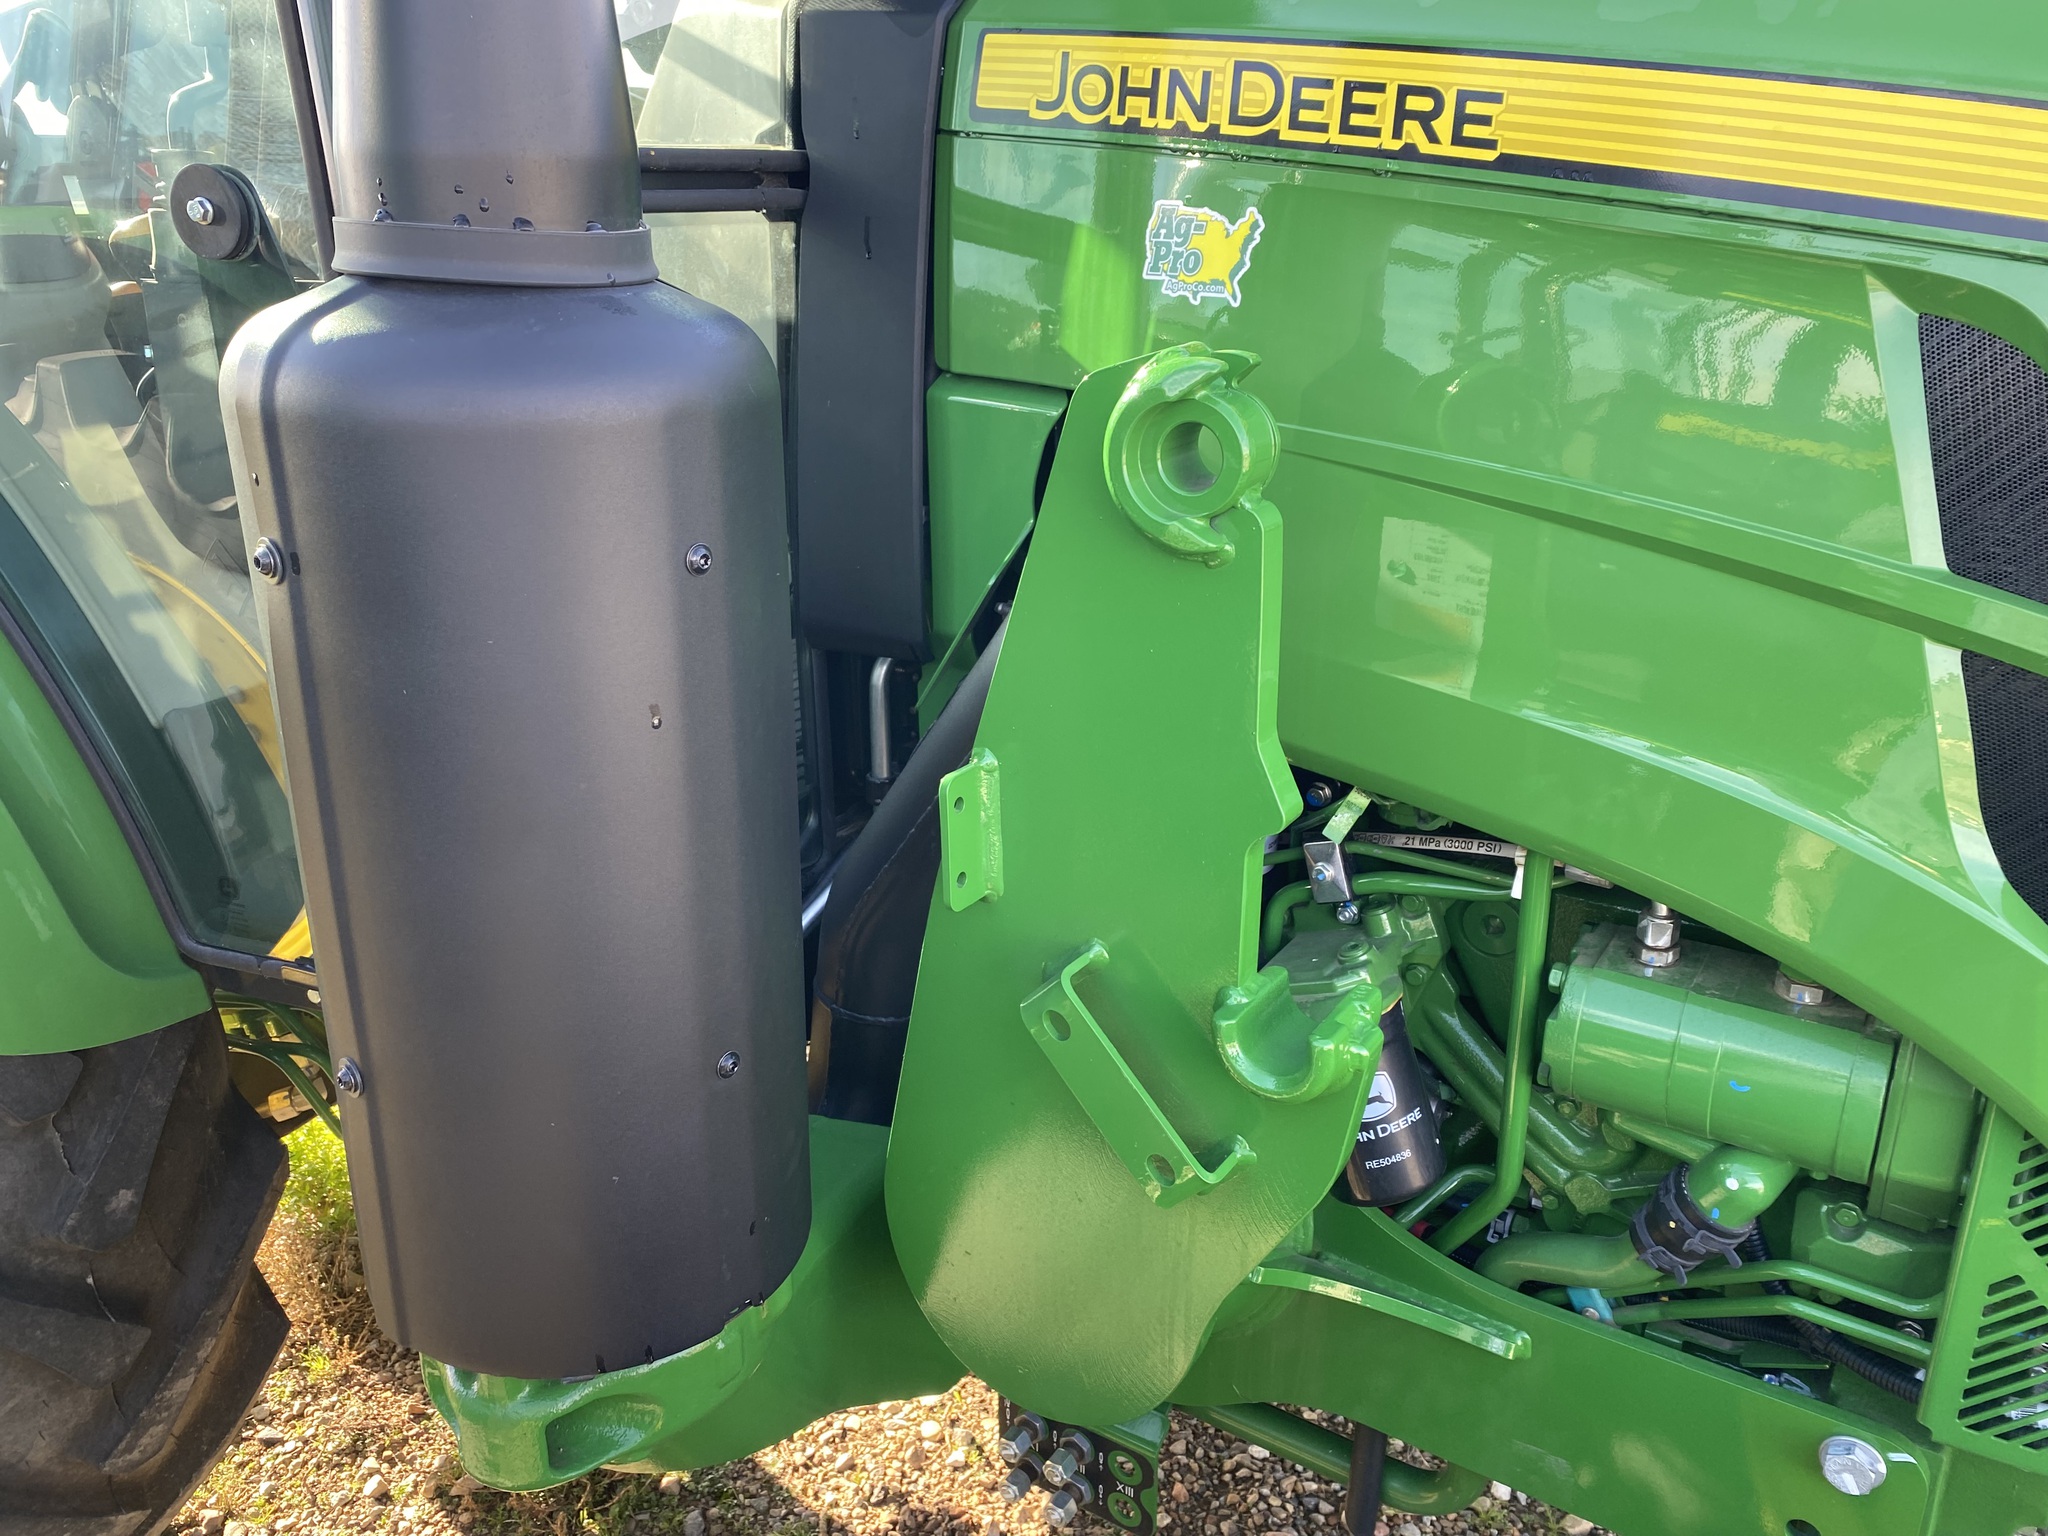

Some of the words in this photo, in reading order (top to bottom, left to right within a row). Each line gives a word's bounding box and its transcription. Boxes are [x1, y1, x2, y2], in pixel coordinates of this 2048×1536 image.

[1033, 50, 1213, 125] JOHN
[1227, 59, 1506, 152] DEERE
[1151, 205, 1207, 249] Ag-
[1147, 240, 1203, 276] Pro
[1166, 281, 1225, 294] AgProCo.com
[1419, 837, 1441, 848] MPa
[1443, 840, 1473, 852] (3000
[1476, 842, 1503, 854] PSI)
[1377, 1106, 1423, 1139] DEERE
[1365, 1148, 1412, 1170] RE504836
[1115, 1480, 1134, 1499] XIII
